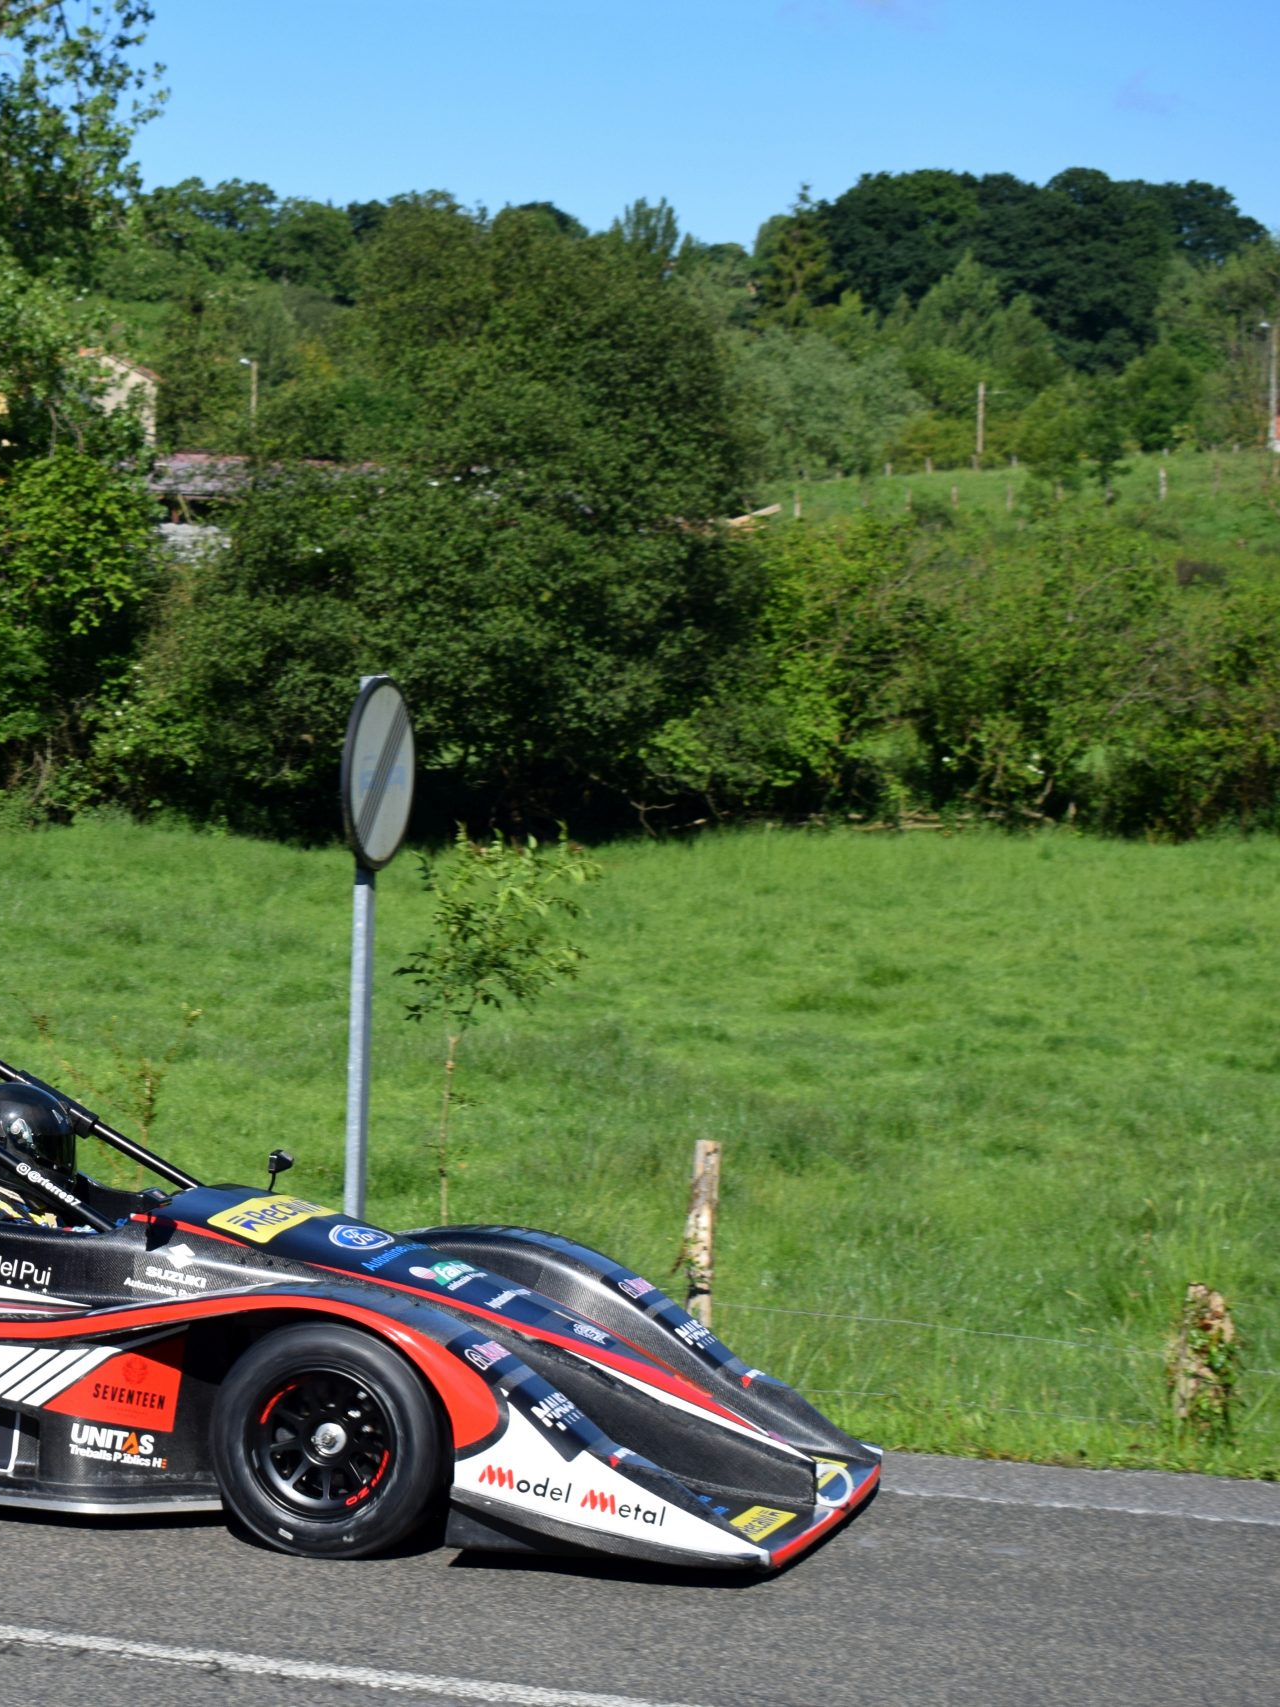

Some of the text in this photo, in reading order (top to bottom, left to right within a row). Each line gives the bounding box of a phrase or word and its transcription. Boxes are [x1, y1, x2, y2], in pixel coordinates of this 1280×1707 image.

[145, 1266, 207, 1288] SUZUKI
[93, 1383, 166, 1410] SEVENTEEN
[71, 1422, 155, 1454] UNITAS
[69, 1444, 113, 1461] Treballs
[478, 1464, 666, 1526] Model Metal
